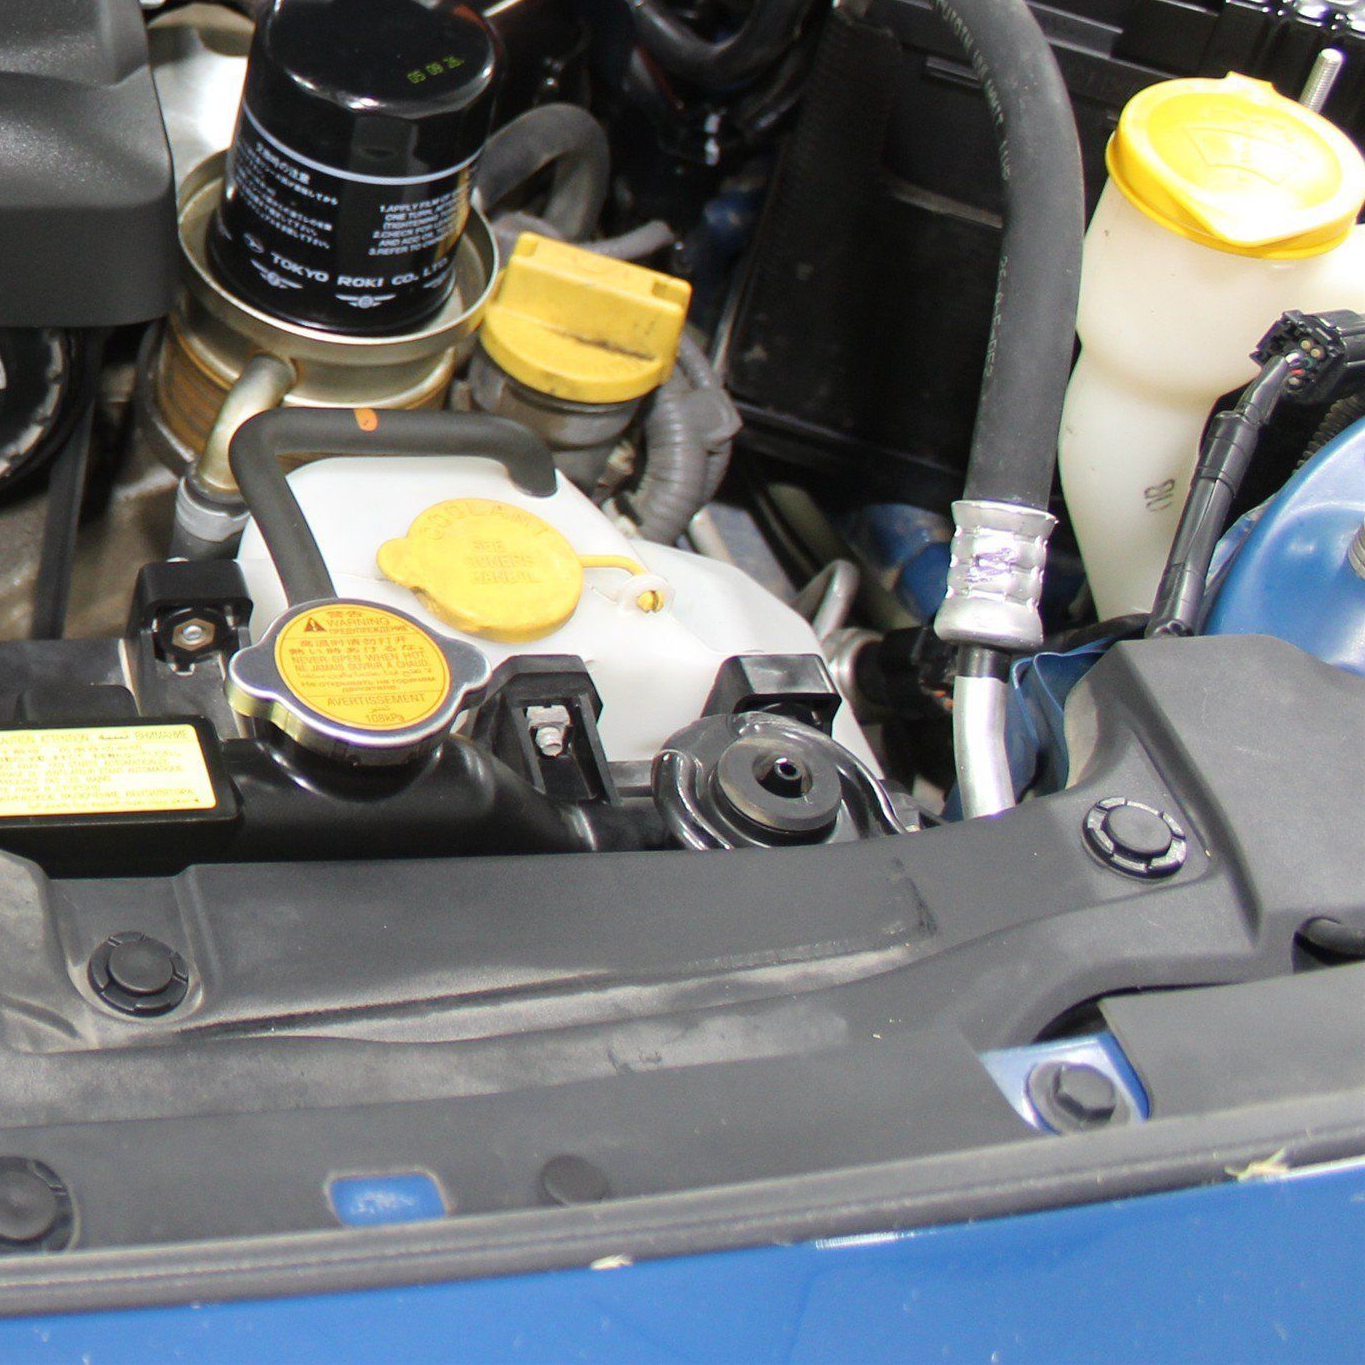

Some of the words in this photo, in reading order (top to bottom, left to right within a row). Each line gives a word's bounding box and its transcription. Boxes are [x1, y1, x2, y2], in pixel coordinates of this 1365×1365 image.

[269, 251, 330, 283] TOKYO
[336, 274, 385, 288] ROKI
[326, 617, 390, 628] WARNING
[291, 655, 327, 665] NEVER
[332, 654, 361, 663] OPEN
[365, 652, 399, 662] WHEN
[327, 693, 427, 707] AVERTISSEMENT
